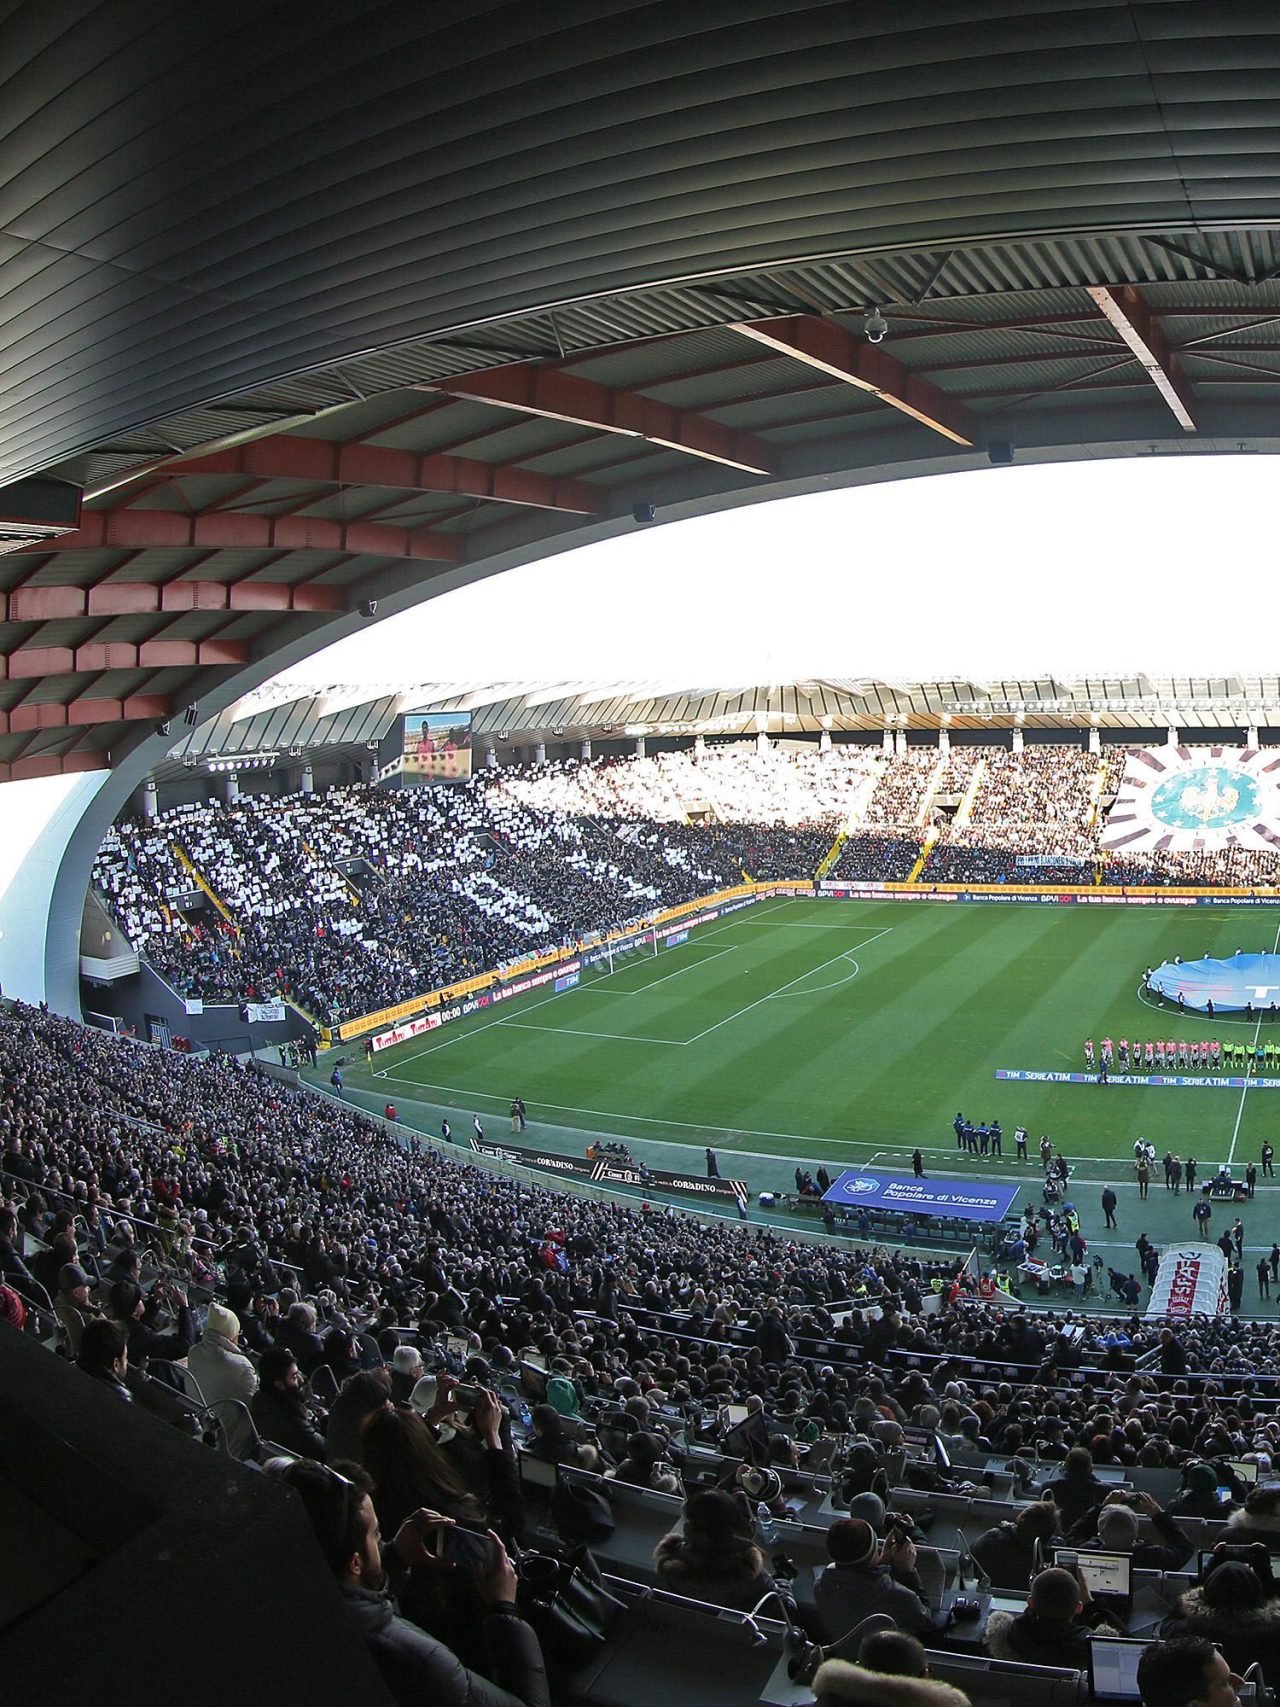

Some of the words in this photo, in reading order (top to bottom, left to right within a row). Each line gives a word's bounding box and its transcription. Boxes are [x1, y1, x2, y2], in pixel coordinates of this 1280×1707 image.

[860, 891, 871, 899] tua
[872, 891, 893, 900] banca
[894, 892, 921, 901] sempre
[928, 893, 958, 902] ovunque
[988, 894, 1010, 902] Popolare
[1077, 895, 1086, 903] La
[1087, 895, 1101, 903] tua
[1102, 895, 1126, 903] banca
[1127, 896, 1156, 905] sempre
[1164, 897, 1197, 905] ovunque
[1230, 897, 1254, 905] Popolare
[492, 991, 502, 1002] La
[501, 987, 512, 999] tua
[512, 979, 531, 995] banca
[531, 972, 553, 989] sempre
[558, 960, 581, 977] ovunque
[565, 975, 579, 986] TIM
[441, 1006, 461, 1022] 00:00
[1053, 1073, 1071, 1081] TIM
[1083, 1074, 1097, 1082] TIM
[1131, 1076, 1149, 1084] TIM
[1162, 1077, 1177, 1085] TIM
[1212, 1077, 1230, 1086] TIM
[1243, 1078, 1257, 1086] TIM
[887, 1182, 924, 1192] Banca
[883, 1189, 935, 1202] Popolare
[936, 1192, 949, 1202] di
[951, 1195, 998, 1206] Vicenza
